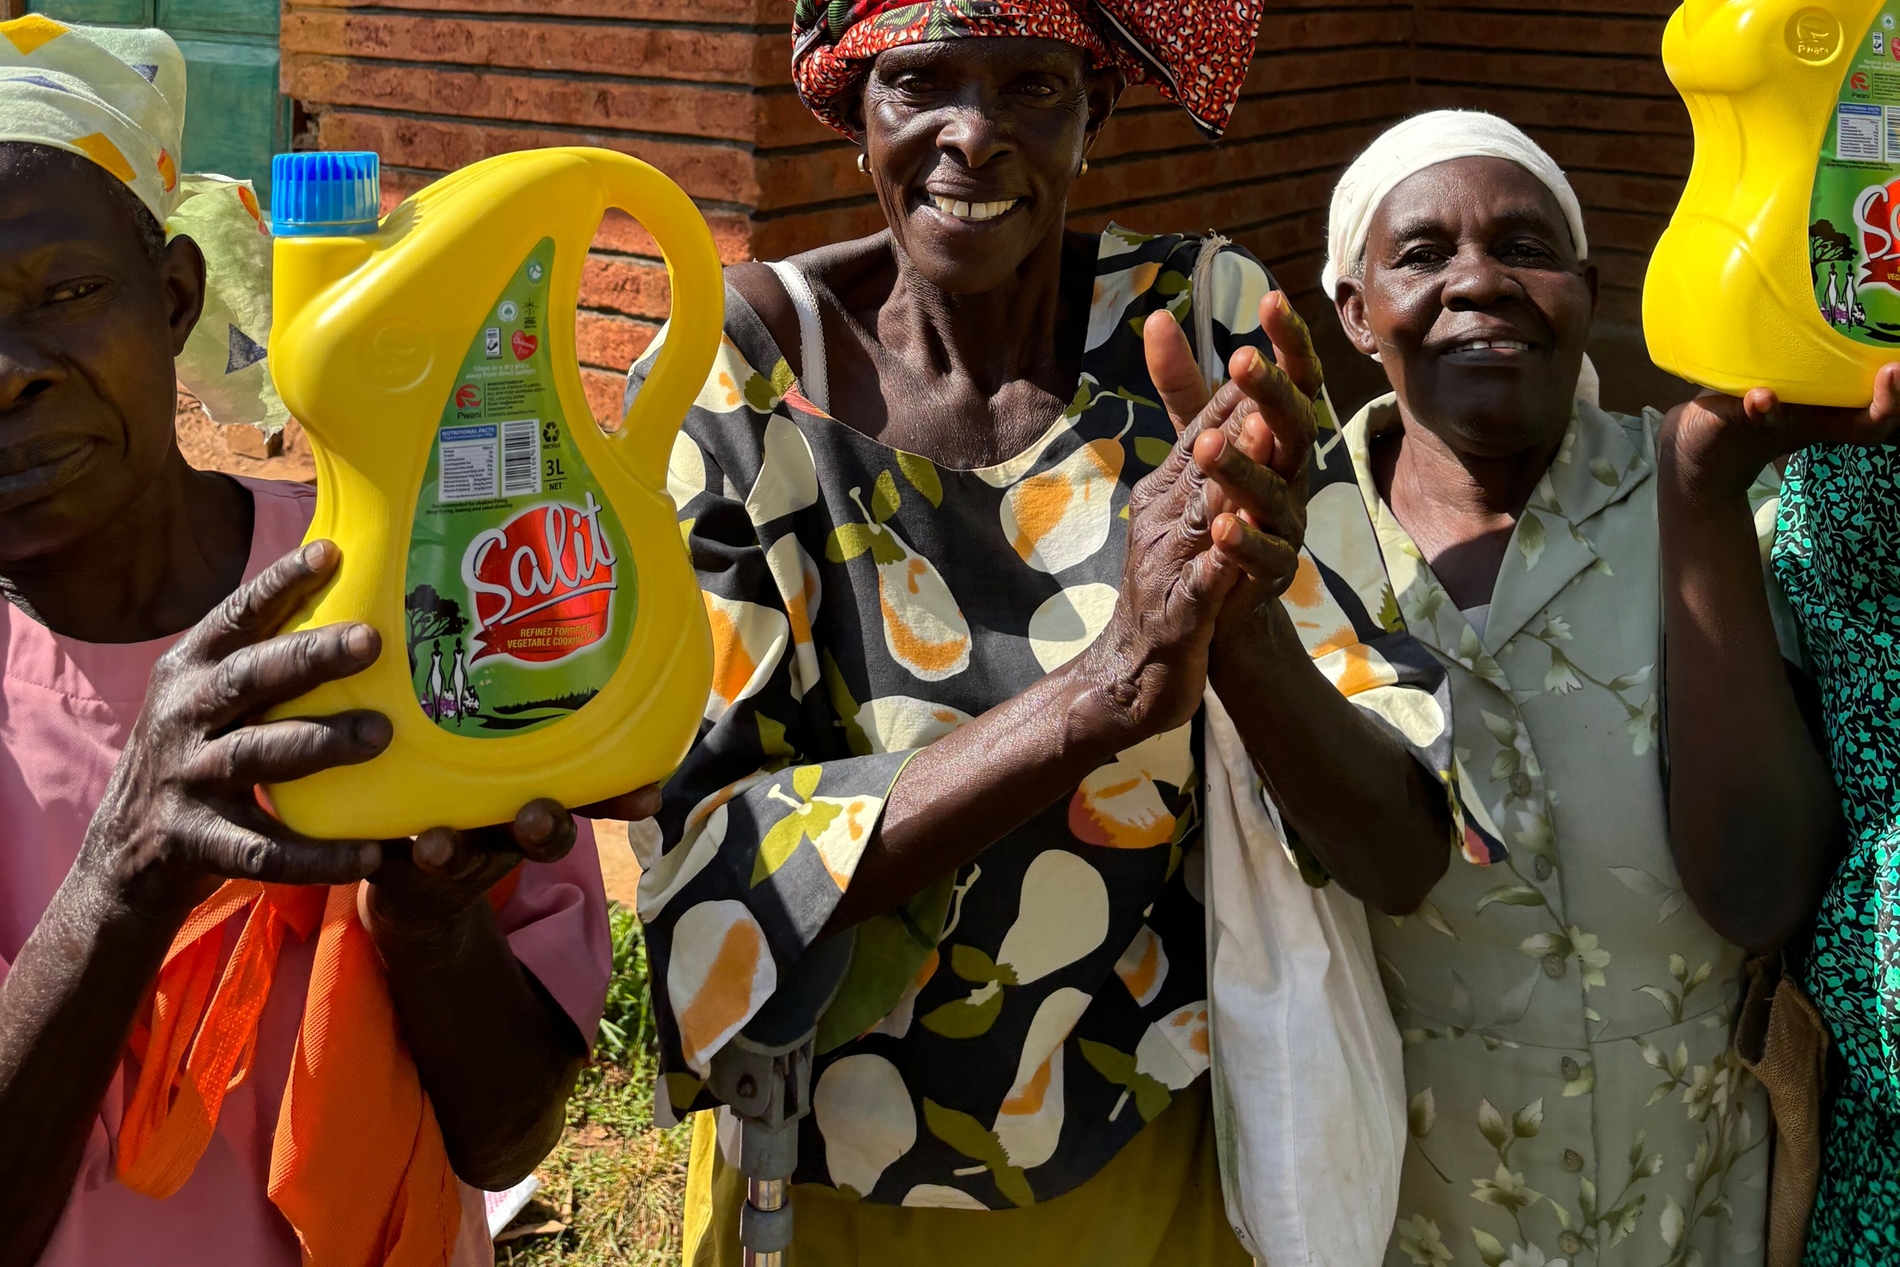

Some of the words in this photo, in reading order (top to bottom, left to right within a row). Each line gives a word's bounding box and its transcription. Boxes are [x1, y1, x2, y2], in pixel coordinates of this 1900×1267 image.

[457, 410, 482, 420] Pwani
[442, 428, 478, 436] NUTRITIONAL
[546, 458, 565, 477] 3L
[549, 482, 562, 491] NET
[461, 491, 617, 626] Salit
[520, 627, 553, 637] REFINED
[555, 622, 591, 635] FORTIFIED
[508, 638, 552, 649] VEGETABLE
[553, 634, 585, 646] COOKING
